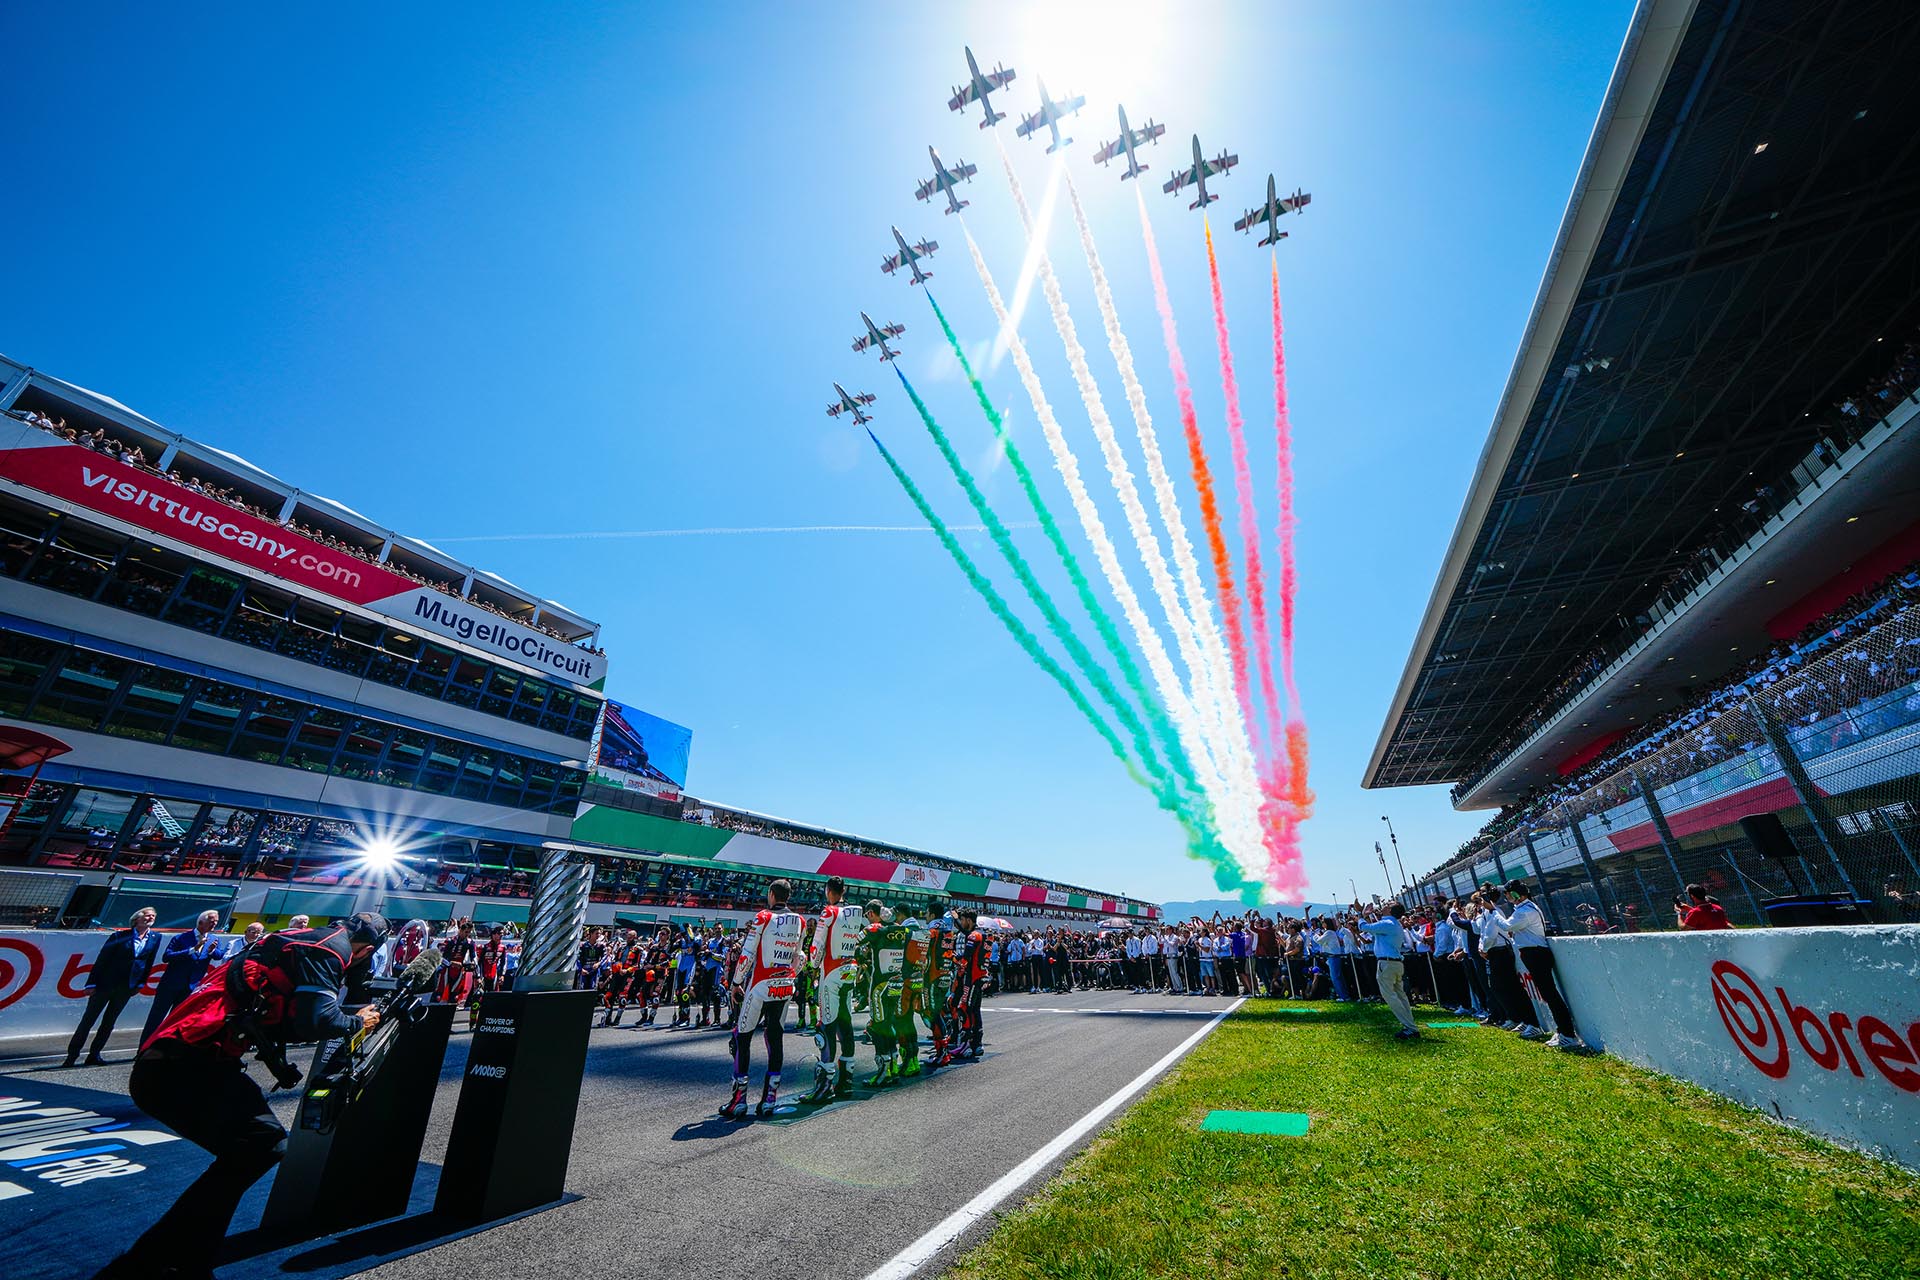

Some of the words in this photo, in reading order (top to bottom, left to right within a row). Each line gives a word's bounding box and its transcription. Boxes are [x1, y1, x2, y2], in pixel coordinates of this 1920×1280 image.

[414, 595, 592, 679] MugelloCircuit
[479, 1025, 516, 1035] CHAMPIONS
[485, 1017, 506, 1026] TOWER
[505, 1018, 515, 1026] OF
[1775, 986, 1920, 1092] bre
[21, 1154, 147, 1188] FOR
